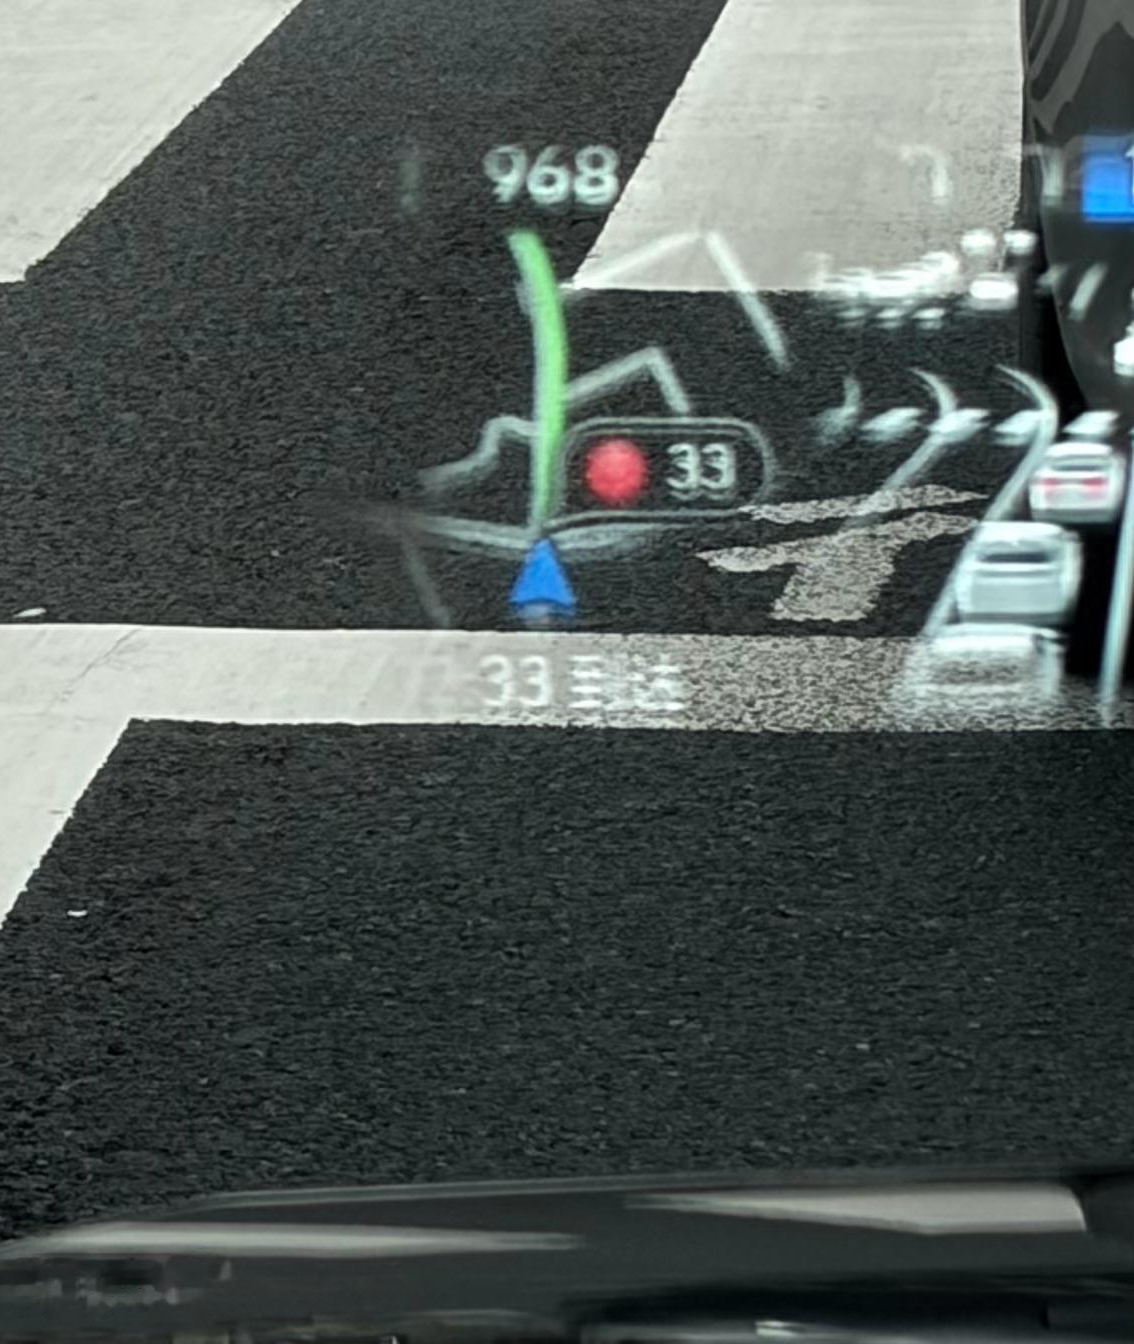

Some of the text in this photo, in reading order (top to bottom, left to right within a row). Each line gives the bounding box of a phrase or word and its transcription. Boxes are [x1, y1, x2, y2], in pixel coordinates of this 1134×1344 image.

[481, 144, 621, 206] 968
[667, 442, 737, 494] 33
[478, 653, 554, 708] 33
